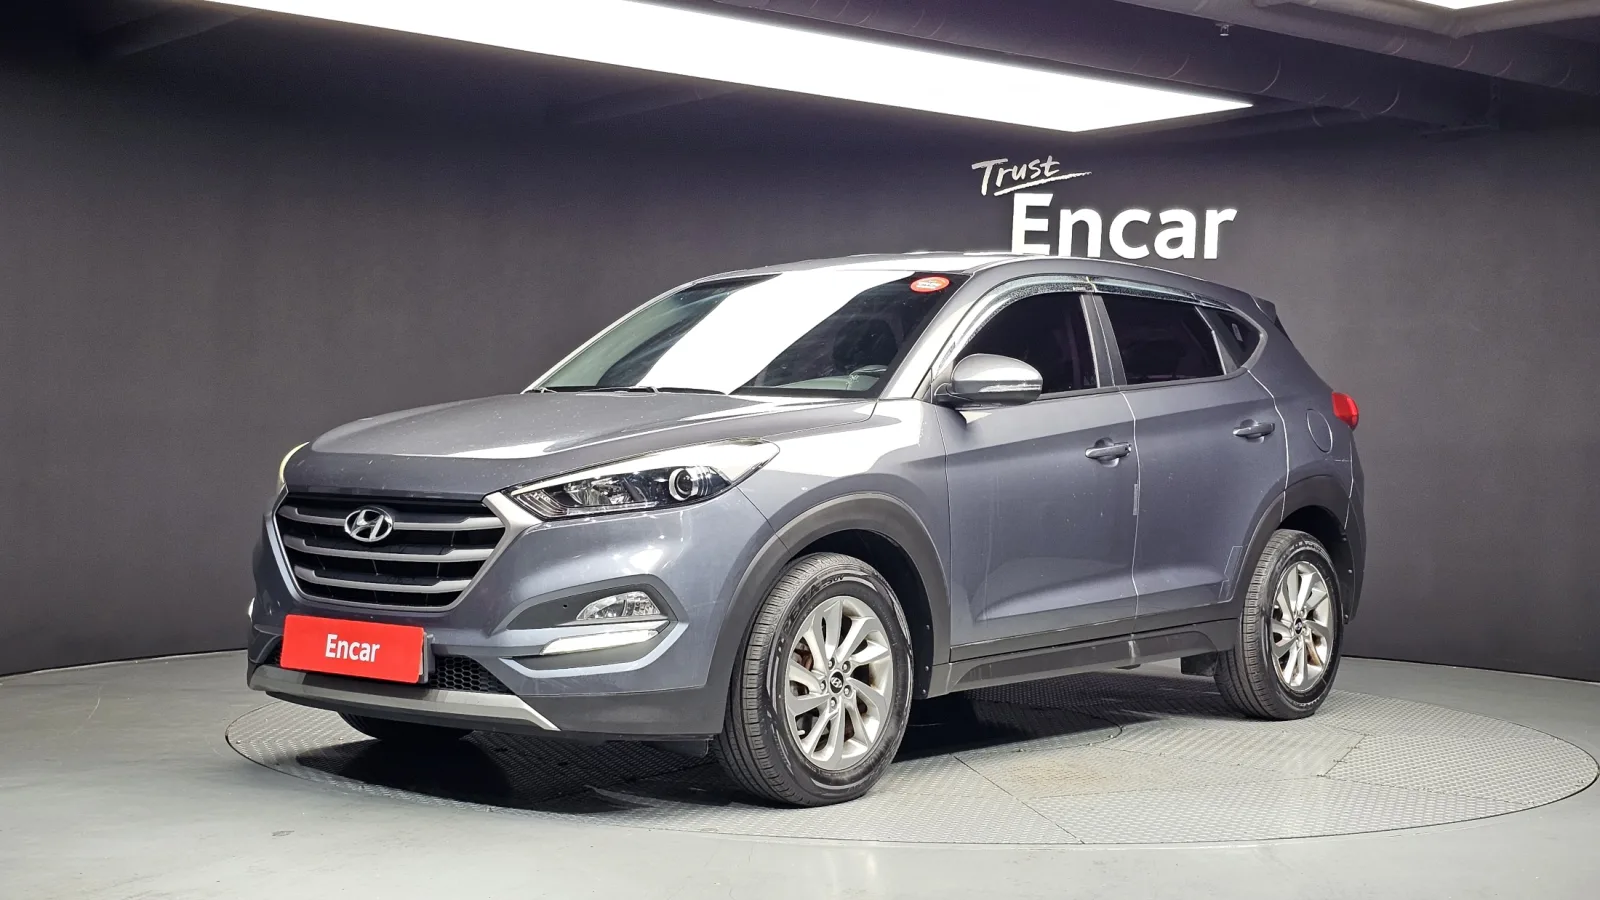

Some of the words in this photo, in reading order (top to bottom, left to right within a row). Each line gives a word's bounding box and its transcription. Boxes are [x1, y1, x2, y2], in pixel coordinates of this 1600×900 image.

[971, 155, 1061, 196] Trust
[1011, 192, 1238, 260] Encar
[325, 633, 381, 663] Encar
